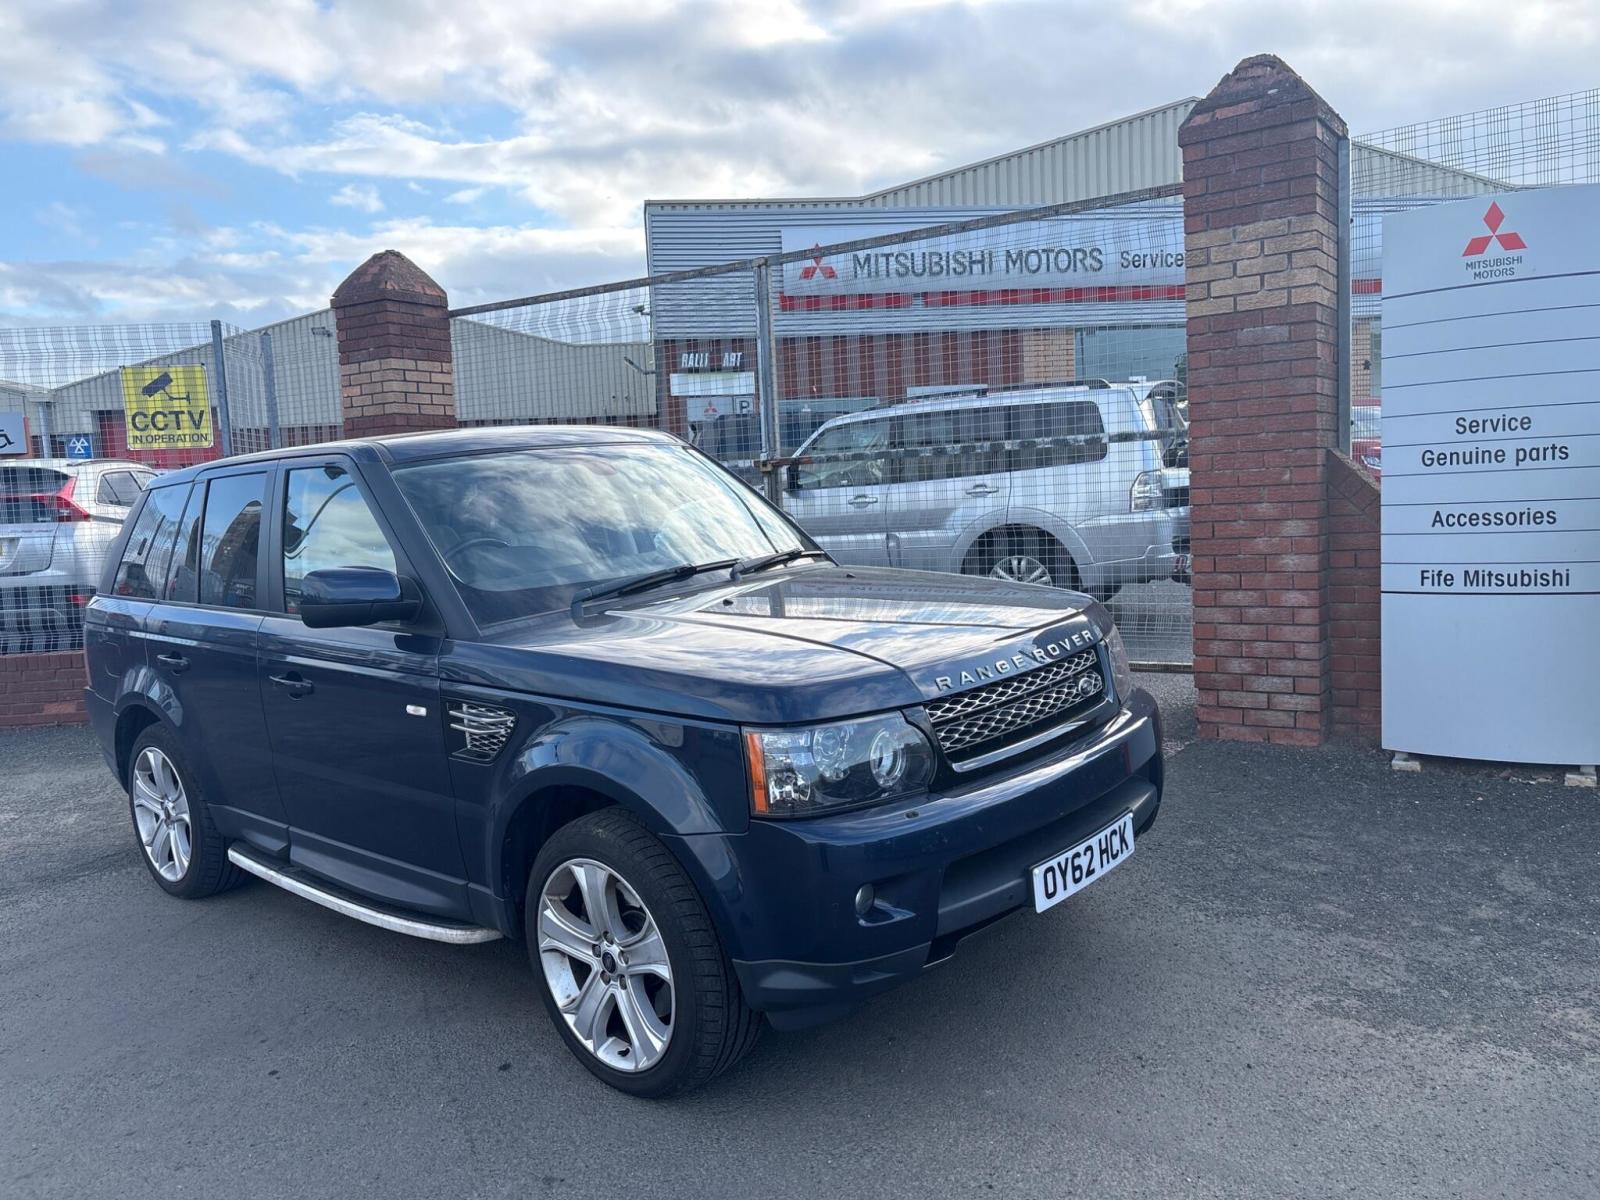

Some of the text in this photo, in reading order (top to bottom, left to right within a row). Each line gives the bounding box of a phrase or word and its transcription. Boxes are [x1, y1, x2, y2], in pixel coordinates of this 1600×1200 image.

[852, 247, 1185, 279] MITSUBISHI MOTORS Service
[1465, 255, 1523, 271] MITSUBISHI
[1473, 266, 1516, 280] MOTORS
[131, 410, 205, 432] CCTV
[1455, 414, 1533, 435] Service
[132, 432, 208, 444] IN OPERATION
[1421, 443, 1570, 467] Genuine parts
[1431, 507, 1558, 528] Accessories
[1420, 568, 1571, 588] Fife Mitsubishi
[935, 629, 1094, 691] RANGE ROVER
[1043, 821, 1130, 900] OY62 HCK
